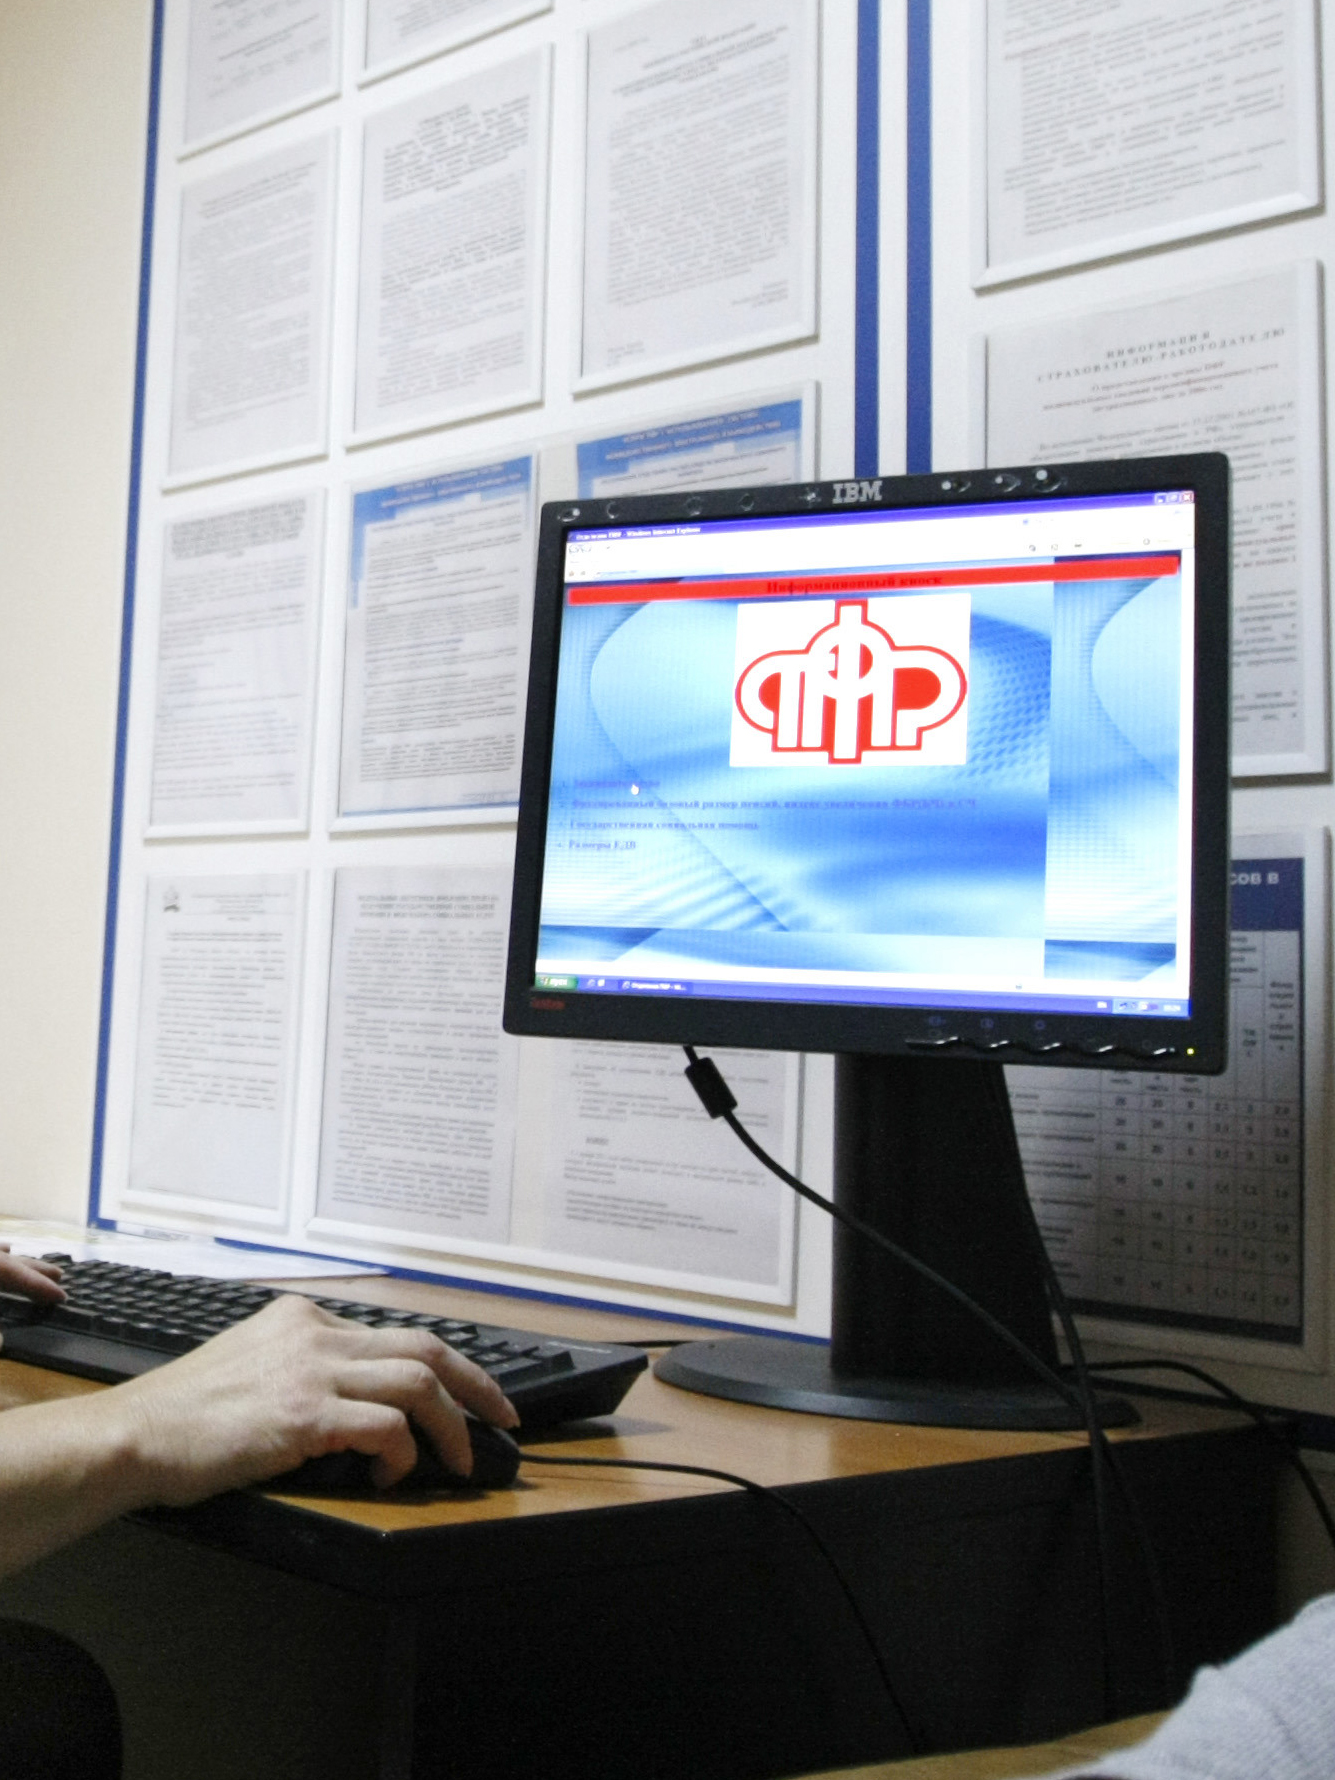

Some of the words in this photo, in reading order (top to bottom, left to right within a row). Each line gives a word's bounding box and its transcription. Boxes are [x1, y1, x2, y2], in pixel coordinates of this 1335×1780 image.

[832, 481, 883, 504] IBM
[767, 576, 895, 595] Информационный
[900, 576, 942, 586] киоск
